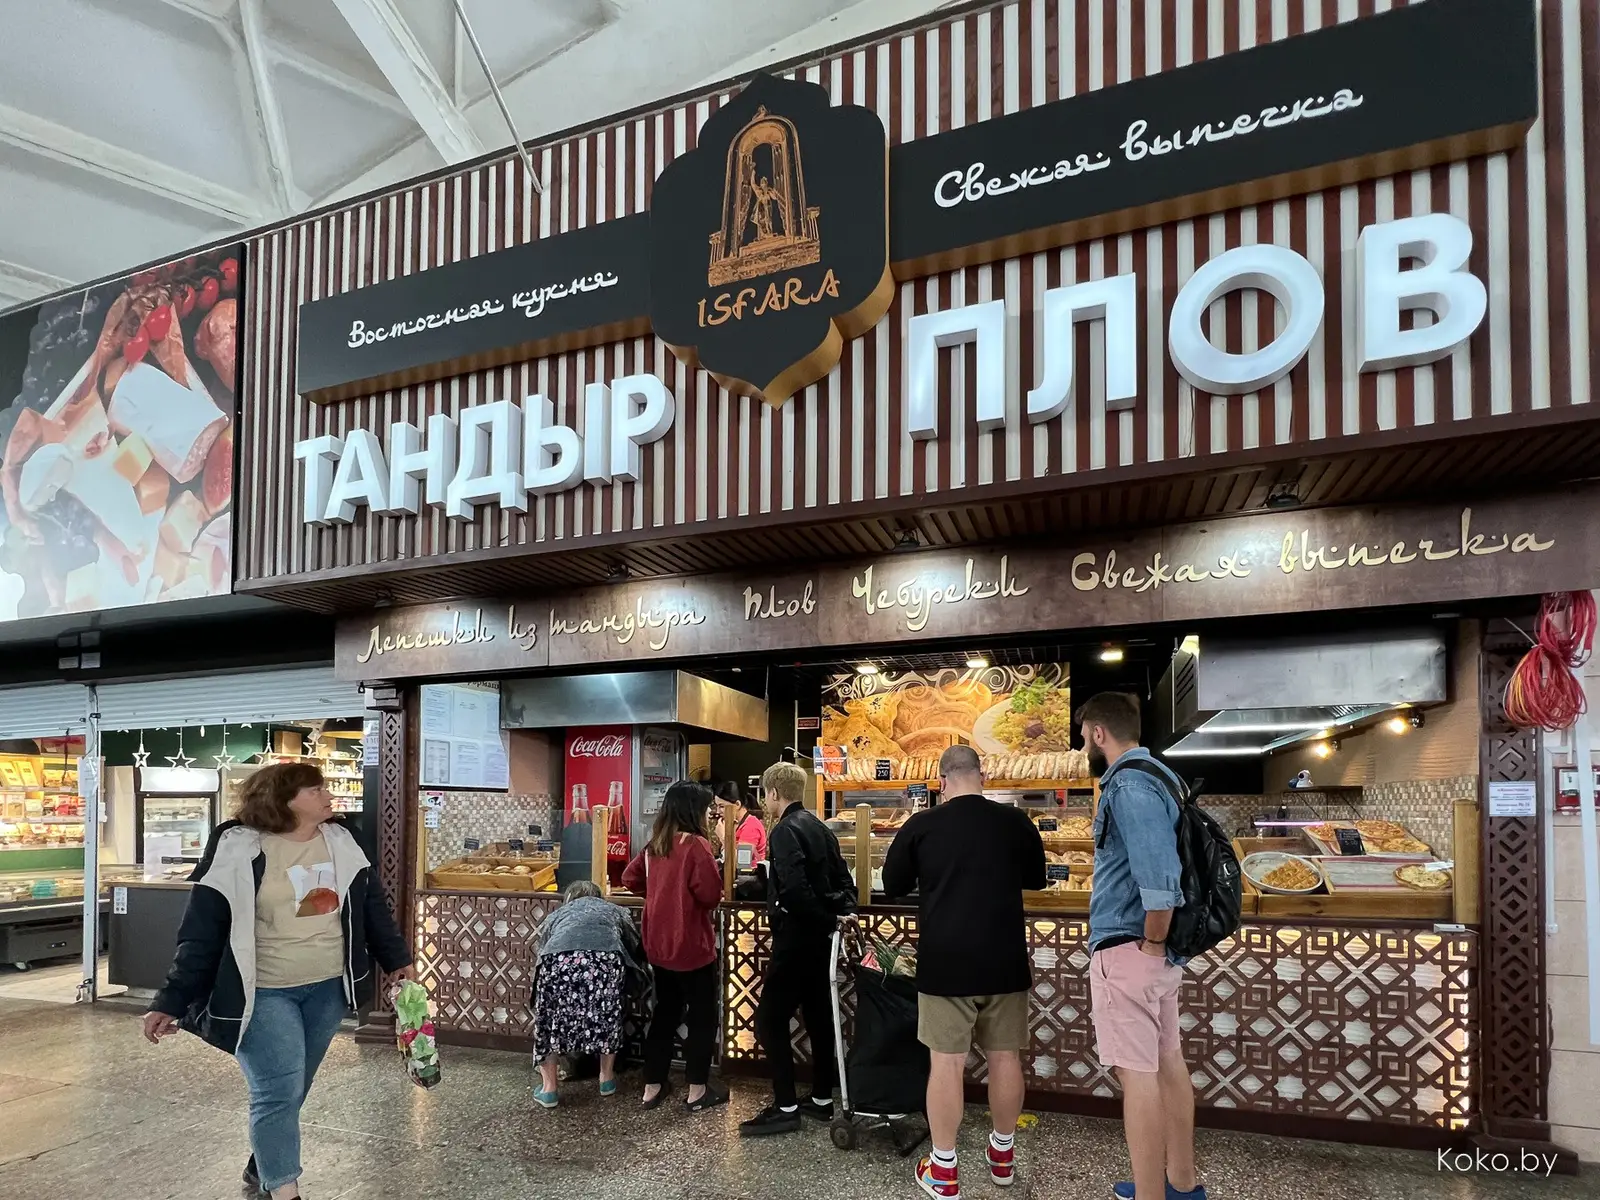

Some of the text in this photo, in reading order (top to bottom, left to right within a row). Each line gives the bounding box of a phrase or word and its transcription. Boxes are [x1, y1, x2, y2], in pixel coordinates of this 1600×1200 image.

[934, 89, 1363, 208] Свежая выпечка
[348, 271, 618, 348] Восточная кухня
[698, 269, 840, 327] ISFARA
[908, 212, 1487, 441] ПЛОВ
[294, 374, 675, 527] ТАНДЫР
[356, 608, 495, 663] Лепешки
[550, 596, 706, 650] тандыра
[742, 580, 816, 620] Плов
[852, 555, 1030, 631] Чебуреки
[1070, 548, 1252, 592] Свежая
[1278, 507, 1555, 574] выпечка
